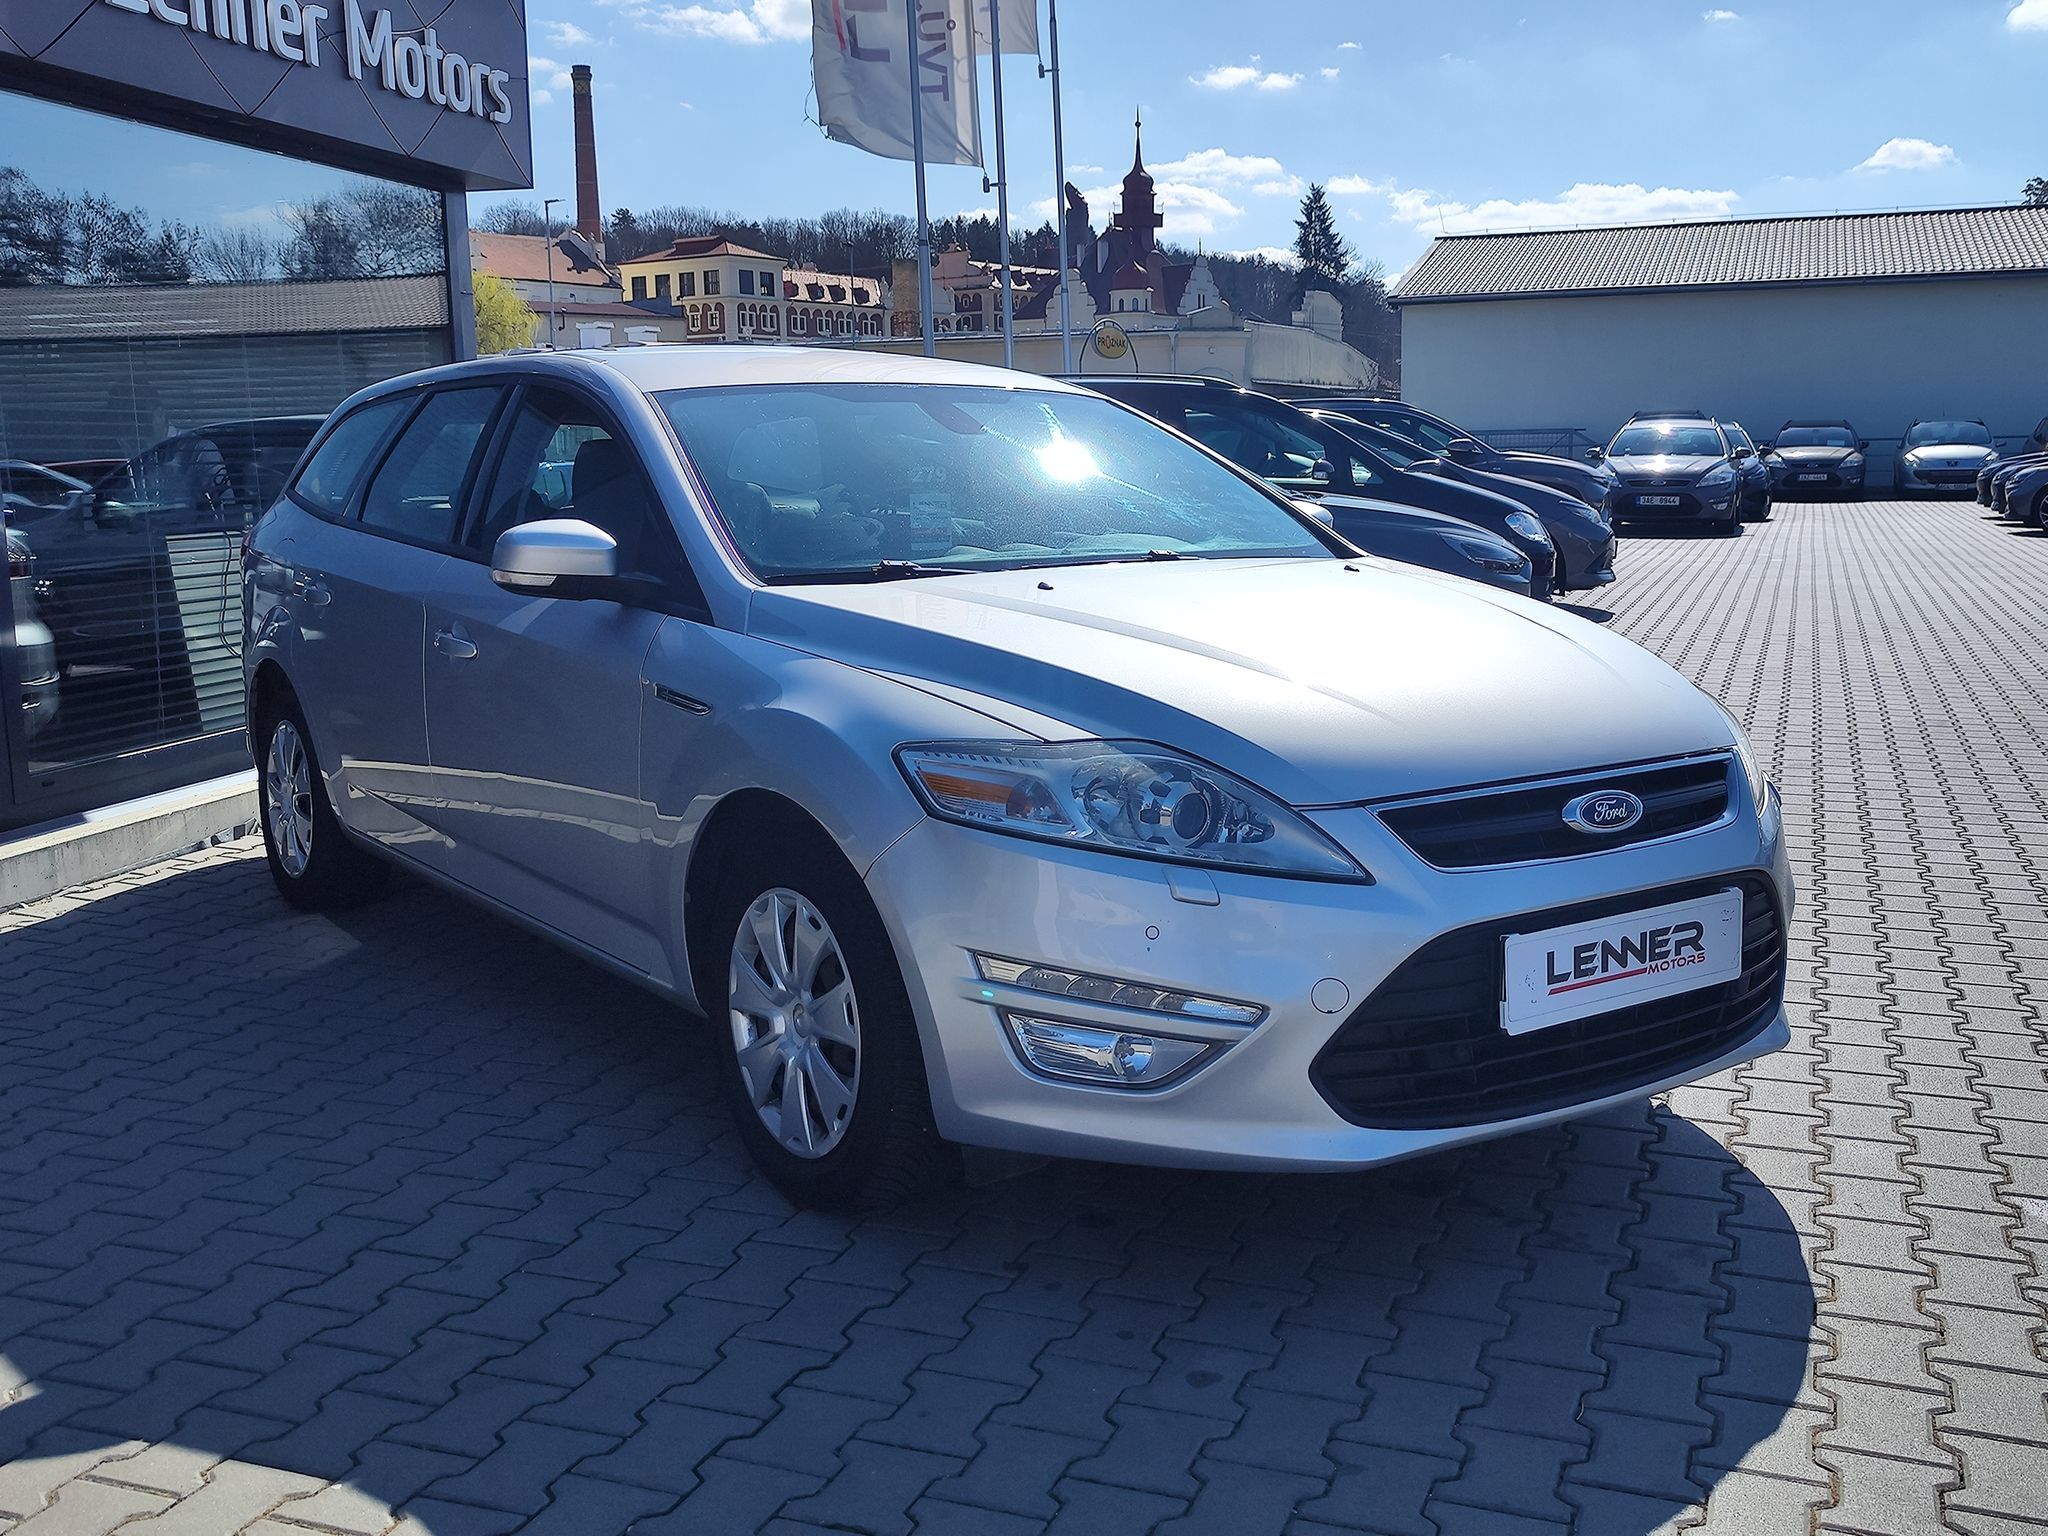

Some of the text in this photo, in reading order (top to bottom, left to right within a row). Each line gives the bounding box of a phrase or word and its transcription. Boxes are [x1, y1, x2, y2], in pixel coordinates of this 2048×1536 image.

[343, 0, 511, 124] Motors
[1594, 799, 1628, 822] Ford
[1546, 920, 1706, 986] LENNER
[1647, 951, 1706, 975] MOTORS
